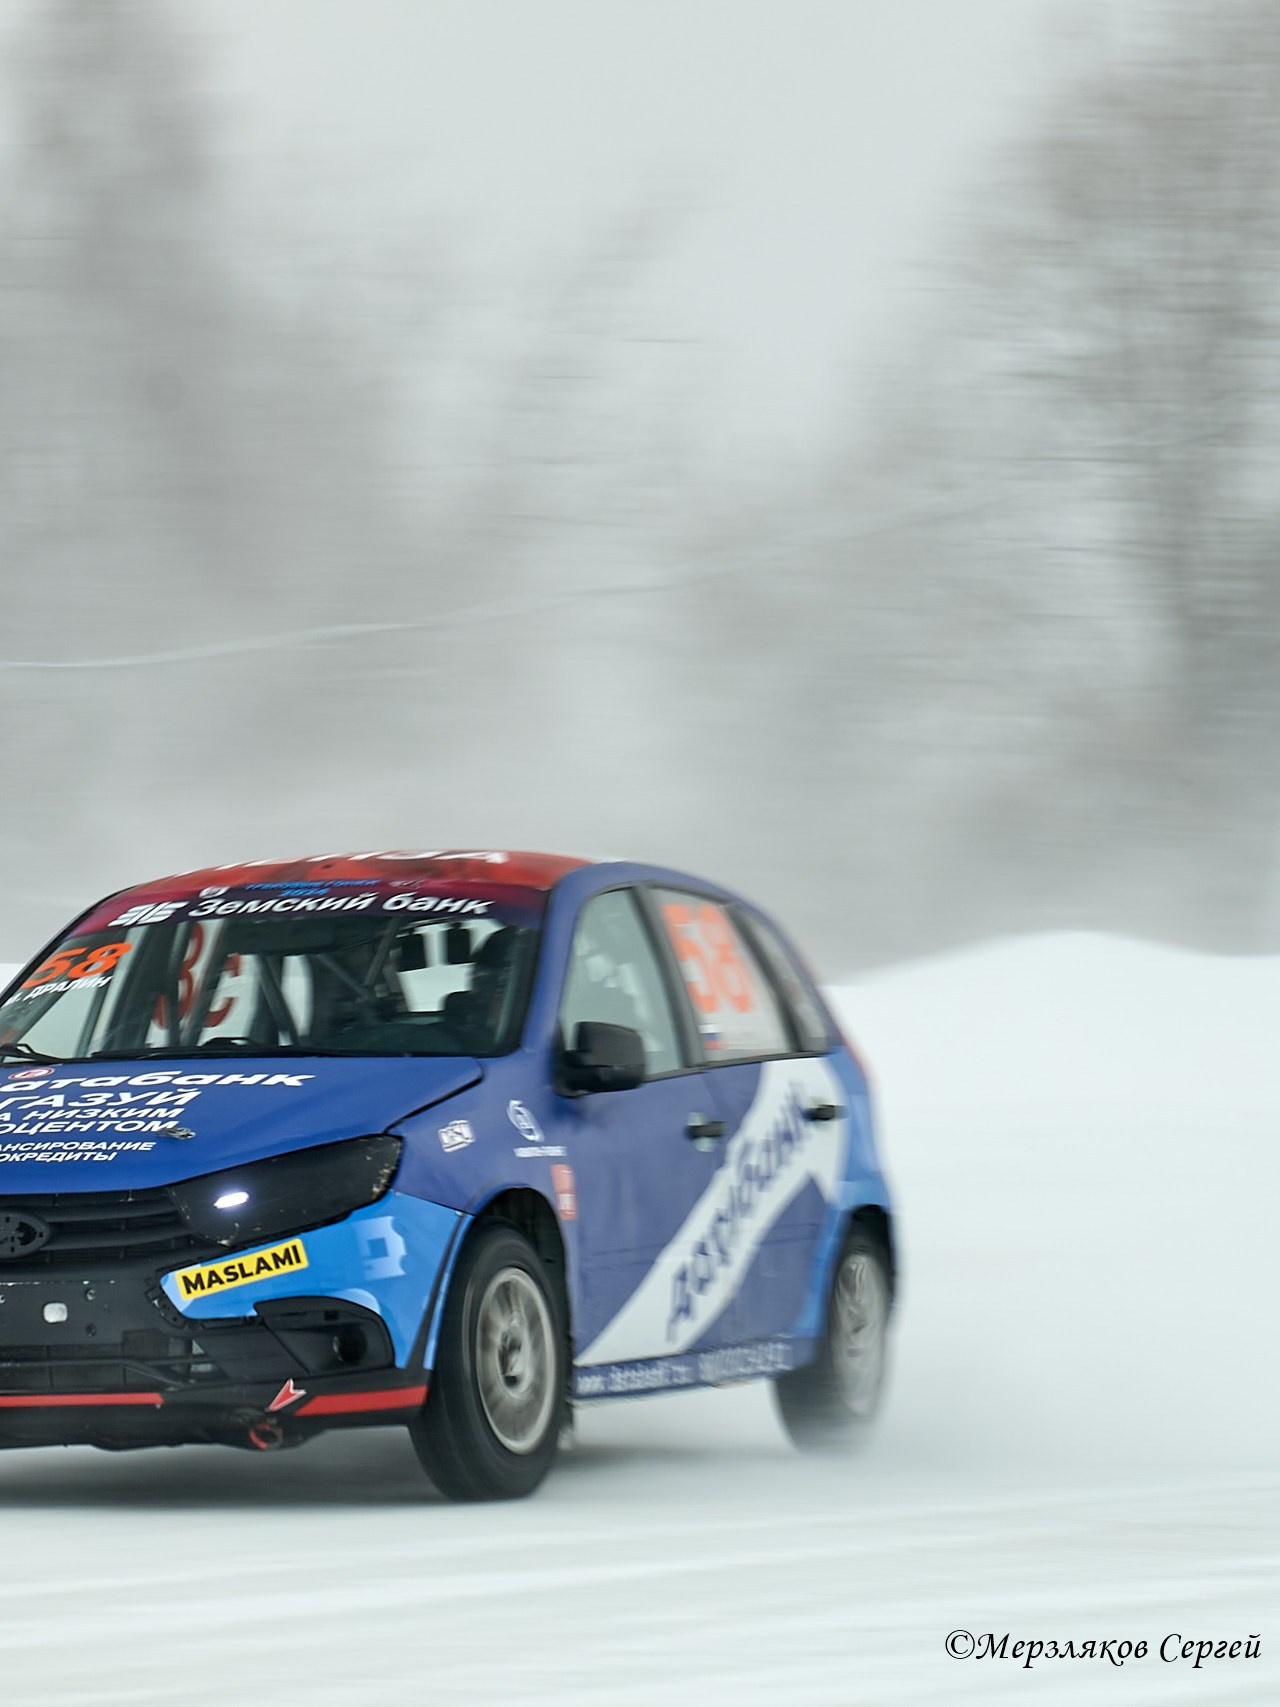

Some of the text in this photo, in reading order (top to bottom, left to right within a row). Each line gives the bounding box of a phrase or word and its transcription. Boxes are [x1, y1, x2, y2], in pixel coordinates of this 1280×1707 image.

[187, 892, 379, 918] Земский
[381, 891, 494, 914] банк
[20, 942, 133, 989] 58
[661, 904, 752, 1013] 58
[23, 1107, 185, 1121] НИЗКИМ
[182, 1244, 302, 1295] MASLAMI
